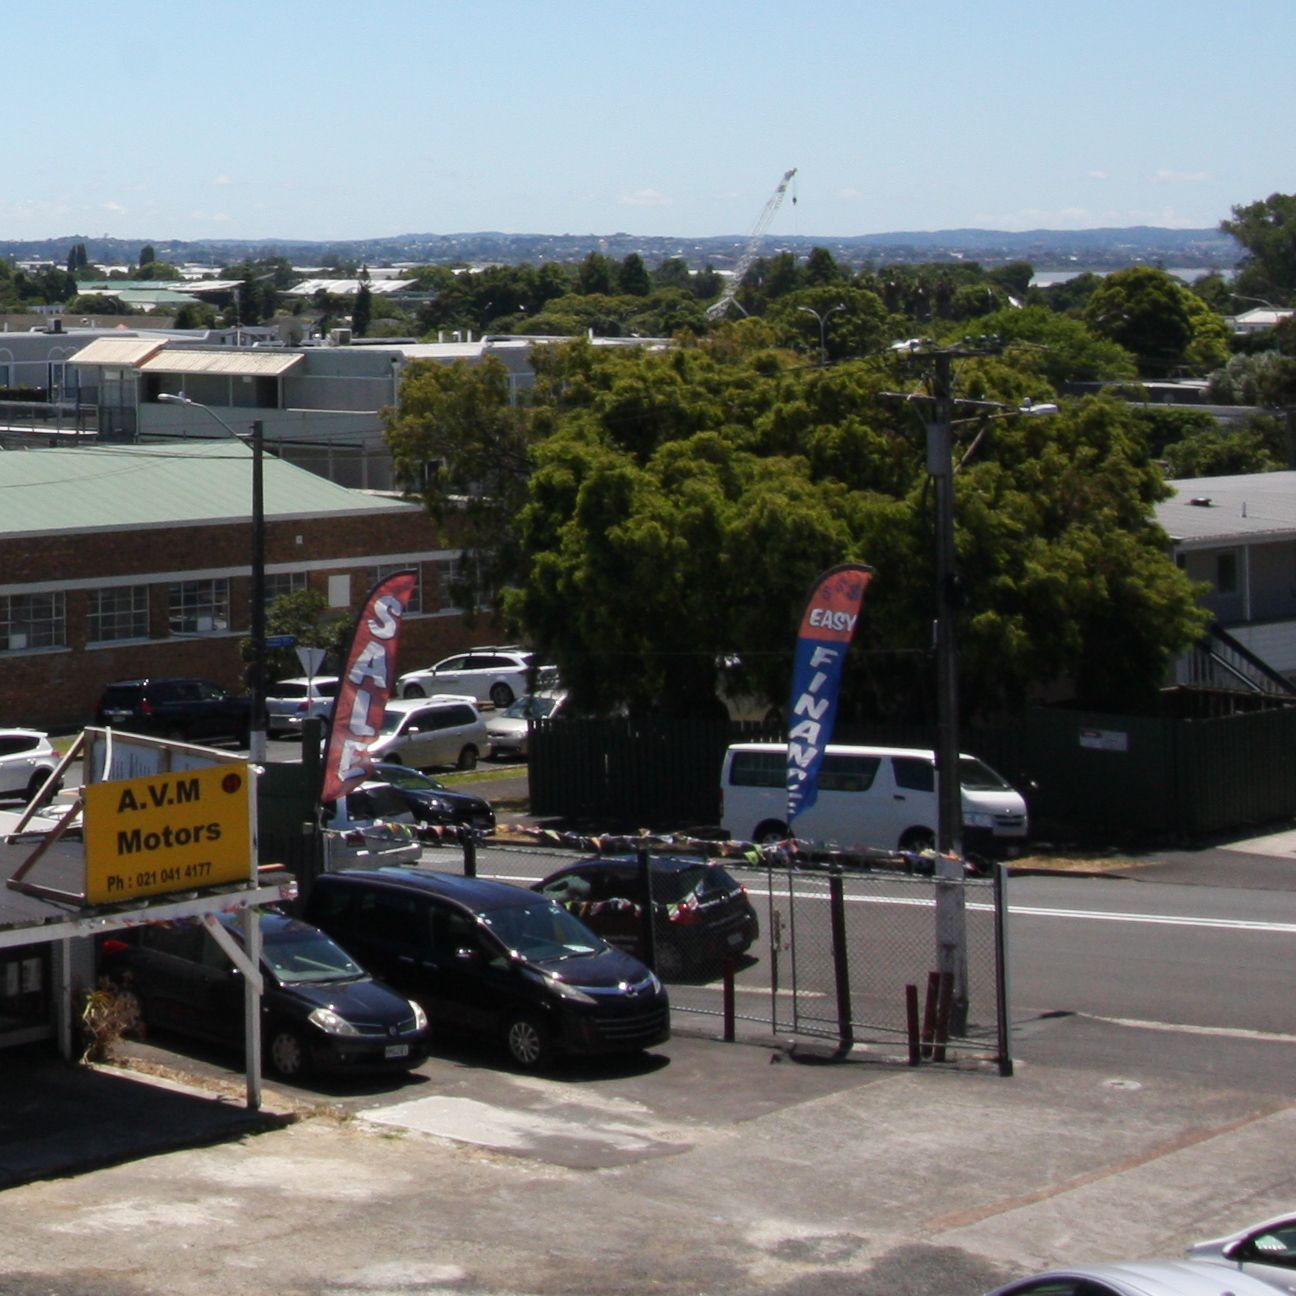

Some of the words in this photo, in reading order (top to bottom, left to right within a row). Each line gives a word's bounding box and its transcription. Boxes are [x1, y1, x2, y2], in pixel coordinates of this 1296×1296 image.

[809, 608, 858, 632] EASY
[337, 594, 403, 783] SALE
[117, 778, 201, 814] A.V.M
[117, 822, 222, 856] Motors
[106, 875, 124, 892] Ph
[136, 868, 157, 887] 021
[160, 865, 181, 884] 041
[184, 862, 212, 879] 4177
